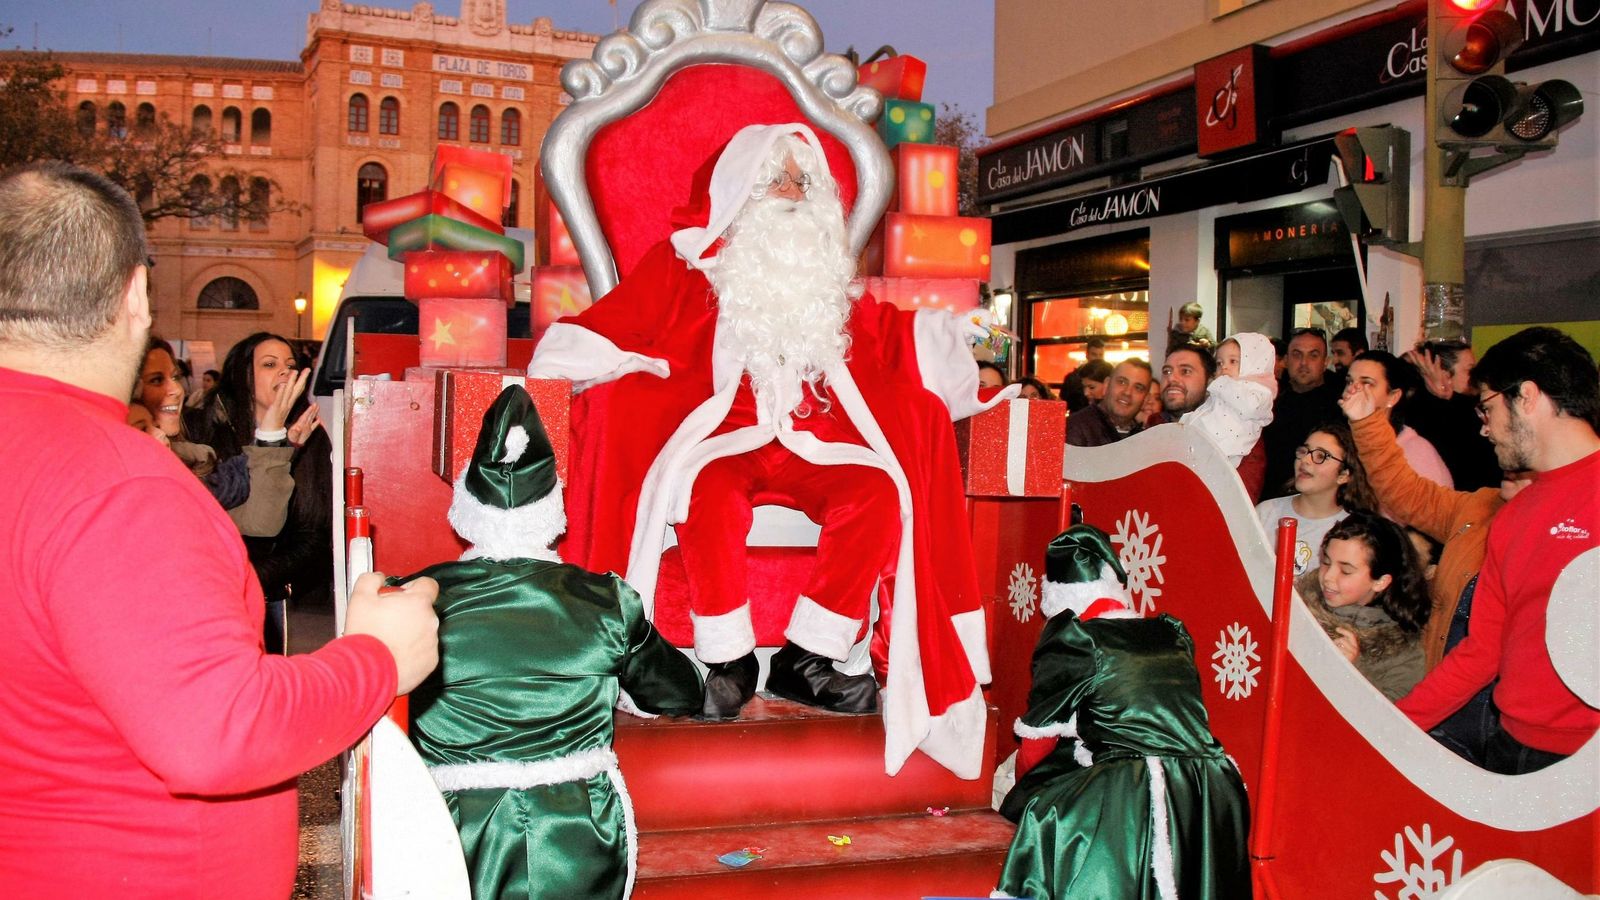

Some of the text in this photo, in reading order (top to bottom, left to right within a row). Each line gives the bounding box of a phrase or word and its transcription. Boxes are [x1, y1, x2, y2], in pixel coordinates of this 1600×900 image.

[439, 56, 528, 79] PLAZA DE TOROS
[988, 167, 1011, 190] Casa
[1012, 165, 1022, 184] del
[997, 159, 1006, 175] La
